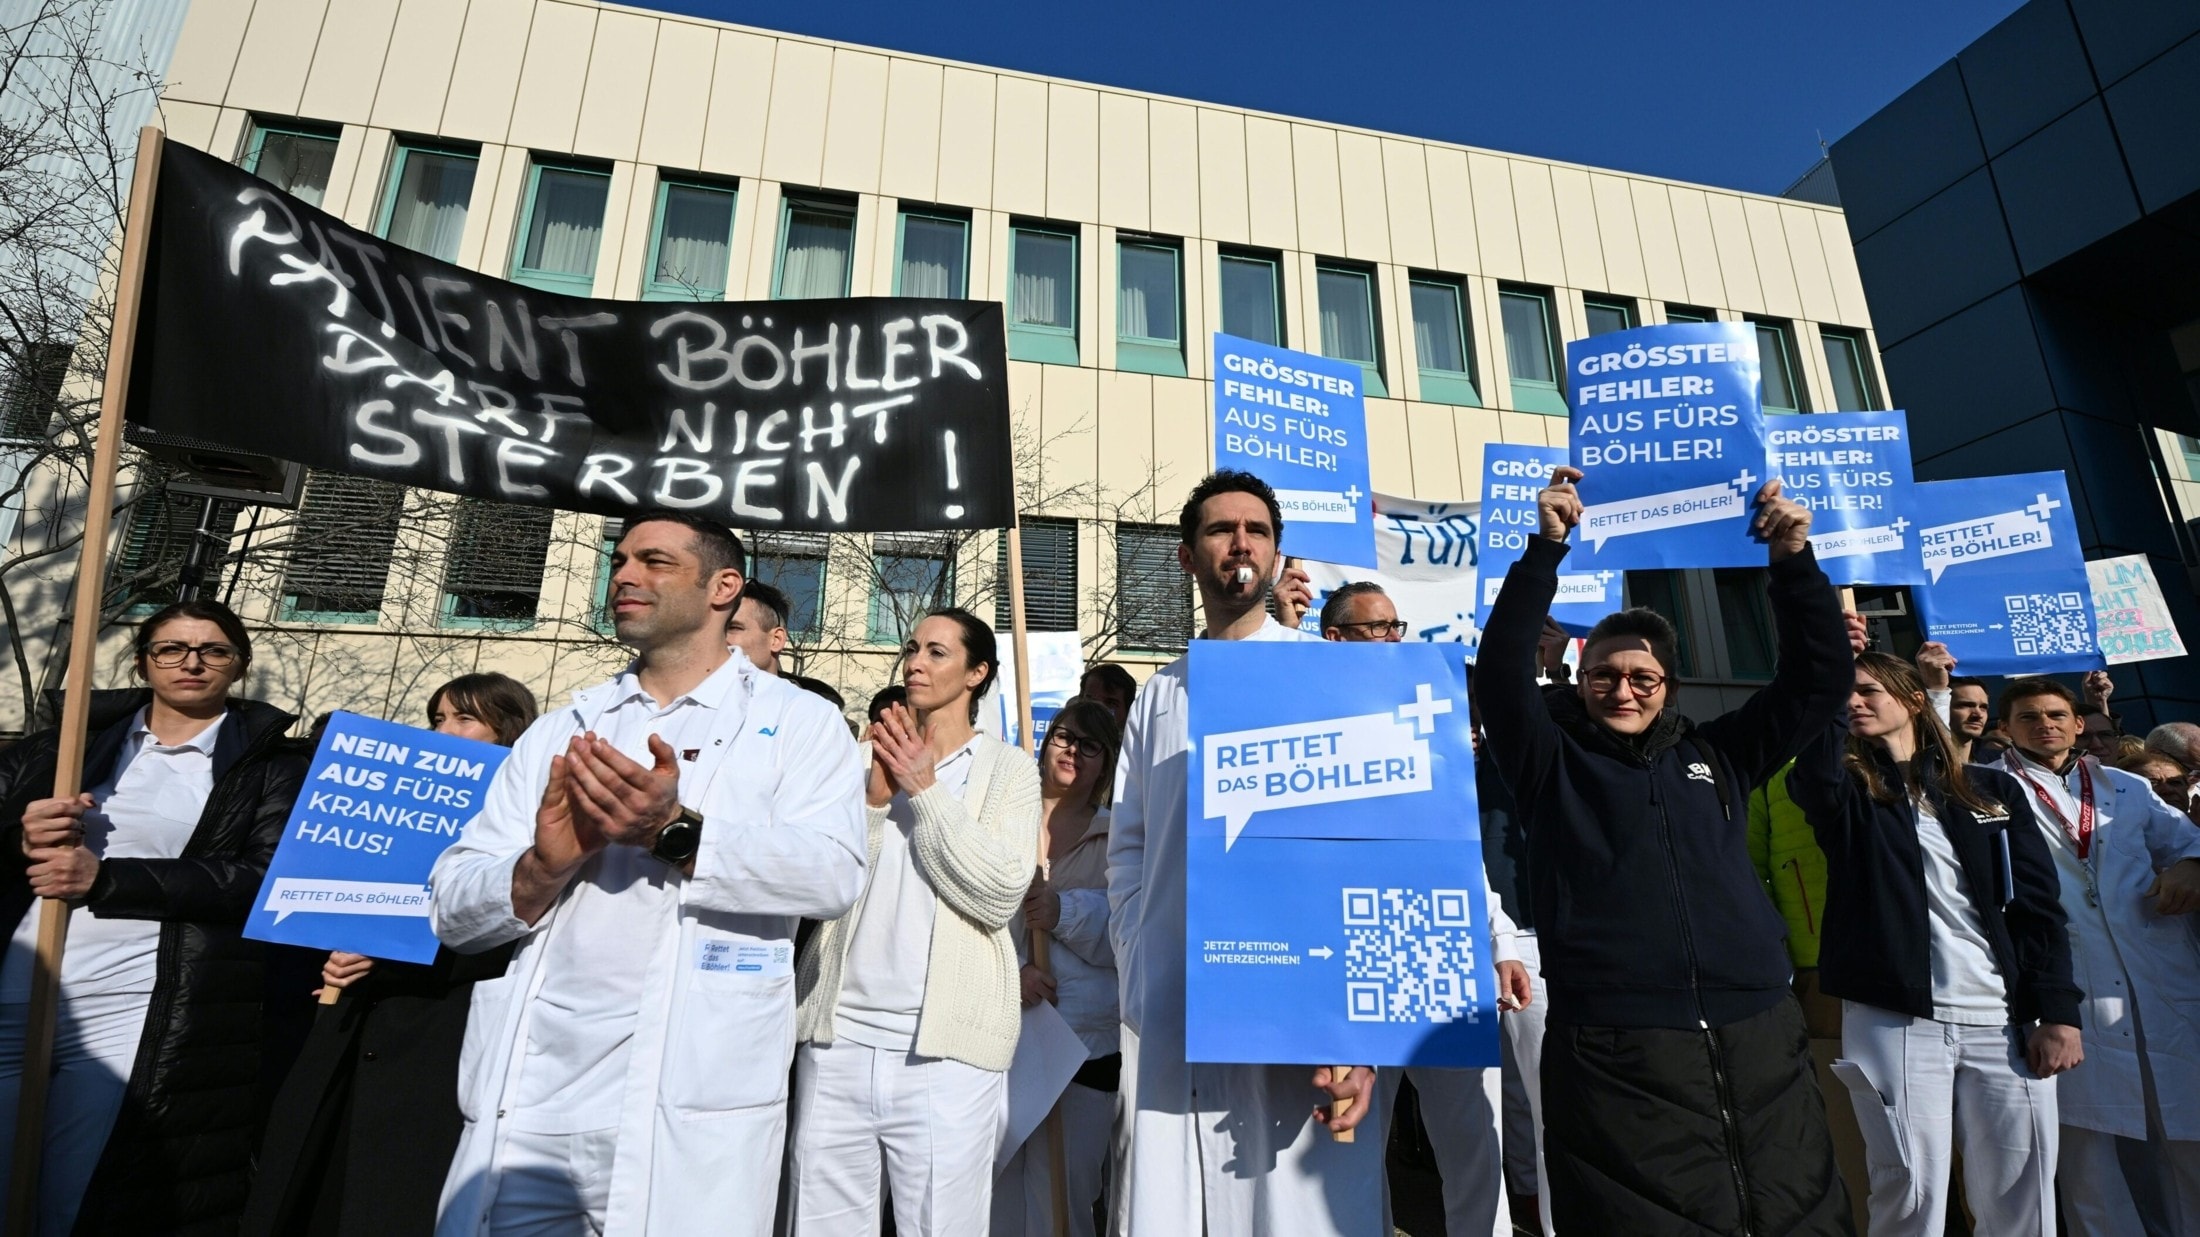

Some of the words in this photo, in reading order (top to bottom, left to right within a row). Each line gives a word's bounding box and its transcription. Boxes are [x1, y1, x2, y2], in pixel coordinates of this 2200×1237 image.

[229, 187, 617, 388] PATIENT
[650, 311, 982, 392] BÖHLER
[1578, 343, 1759, 376] GRÖSSTER
[322, 322, 592, 443] DARF
[660, 395, 914, 455] NICHT
[1223, 353, 1355, 398] GRÖSSTER
[1579, 376, 1714, 405] FEHLER:
[1224, 379, 1330, 418] FEHLER:
[1224, 407, 1277, 432] AUS
[1284, 417, 1348, 447] FÜRS
[1579, 411, 1643, 436] AUS
[1654, 403, 1738, 430] FÜRS
[1768, 425, 1900, 445] GRÖSSTER
[350, 400, 861, 523] STERBEN
[943, 429, 965, 519] !
[1226, 433, 1338, 472] BÖHLER!
[1582, 438, 1723, 467] BÖHLER!
[1770, 450, 1874, 467] FEHLER:
[1491, 458, 1557, 479] GRÖS
[1776, 473, 1821, 489] AUS
[1828, 469, 1893, 488] FÜRS
[1302, 500, 1347, 512] BÖHLER!
[1488, 508, 1536, 526] AUS
[1590, 511, 1638, 528] RETTET
[1641, 507, 1669, 520] DAS
[1673, 495, 1733, 515] BÖHLER!
[1791, 493, 1883, 511] ÖHLER!
[1386, 504, 1479, 567] FÜR
[1825, 539, 1847, 550] DAS
[1920, 522, 1995, 547] RETTET
[1923, 548, 1947, 559] DAS
[1951, 530, 2042, 558] BÖHLER!
[1930, 628, 1985, 636] UNTERZEICHNEN!
[2101, 628, 2181, 657] BÖHLER
[330, 732, 410, 766] NEIN
[413, 750, 485, 781] ZUM
[1216, 731, 1344, 769] RETTET
[317, 763, 387, 791] AUS
[393, 777, 473, 809] FÜRS
[1217, 774, 1258, 794] DAS
[1265, 756, 1416, 797] BÖHLER!
[308, 791, 463, 838] KRANKEN-
[295, 820, 394, 856] HAUS!
[280, 890, 333, 901] RETTET
[335, 892, 363, 903] DAS
[366, 892, 424, 906] BÖHLER!
[1204, 940, 1236, 951] JETZT
[1238, 941, 1289, 952] PETITION
[1204, 953, 1301, 965] UNTERZEICHNEN!
